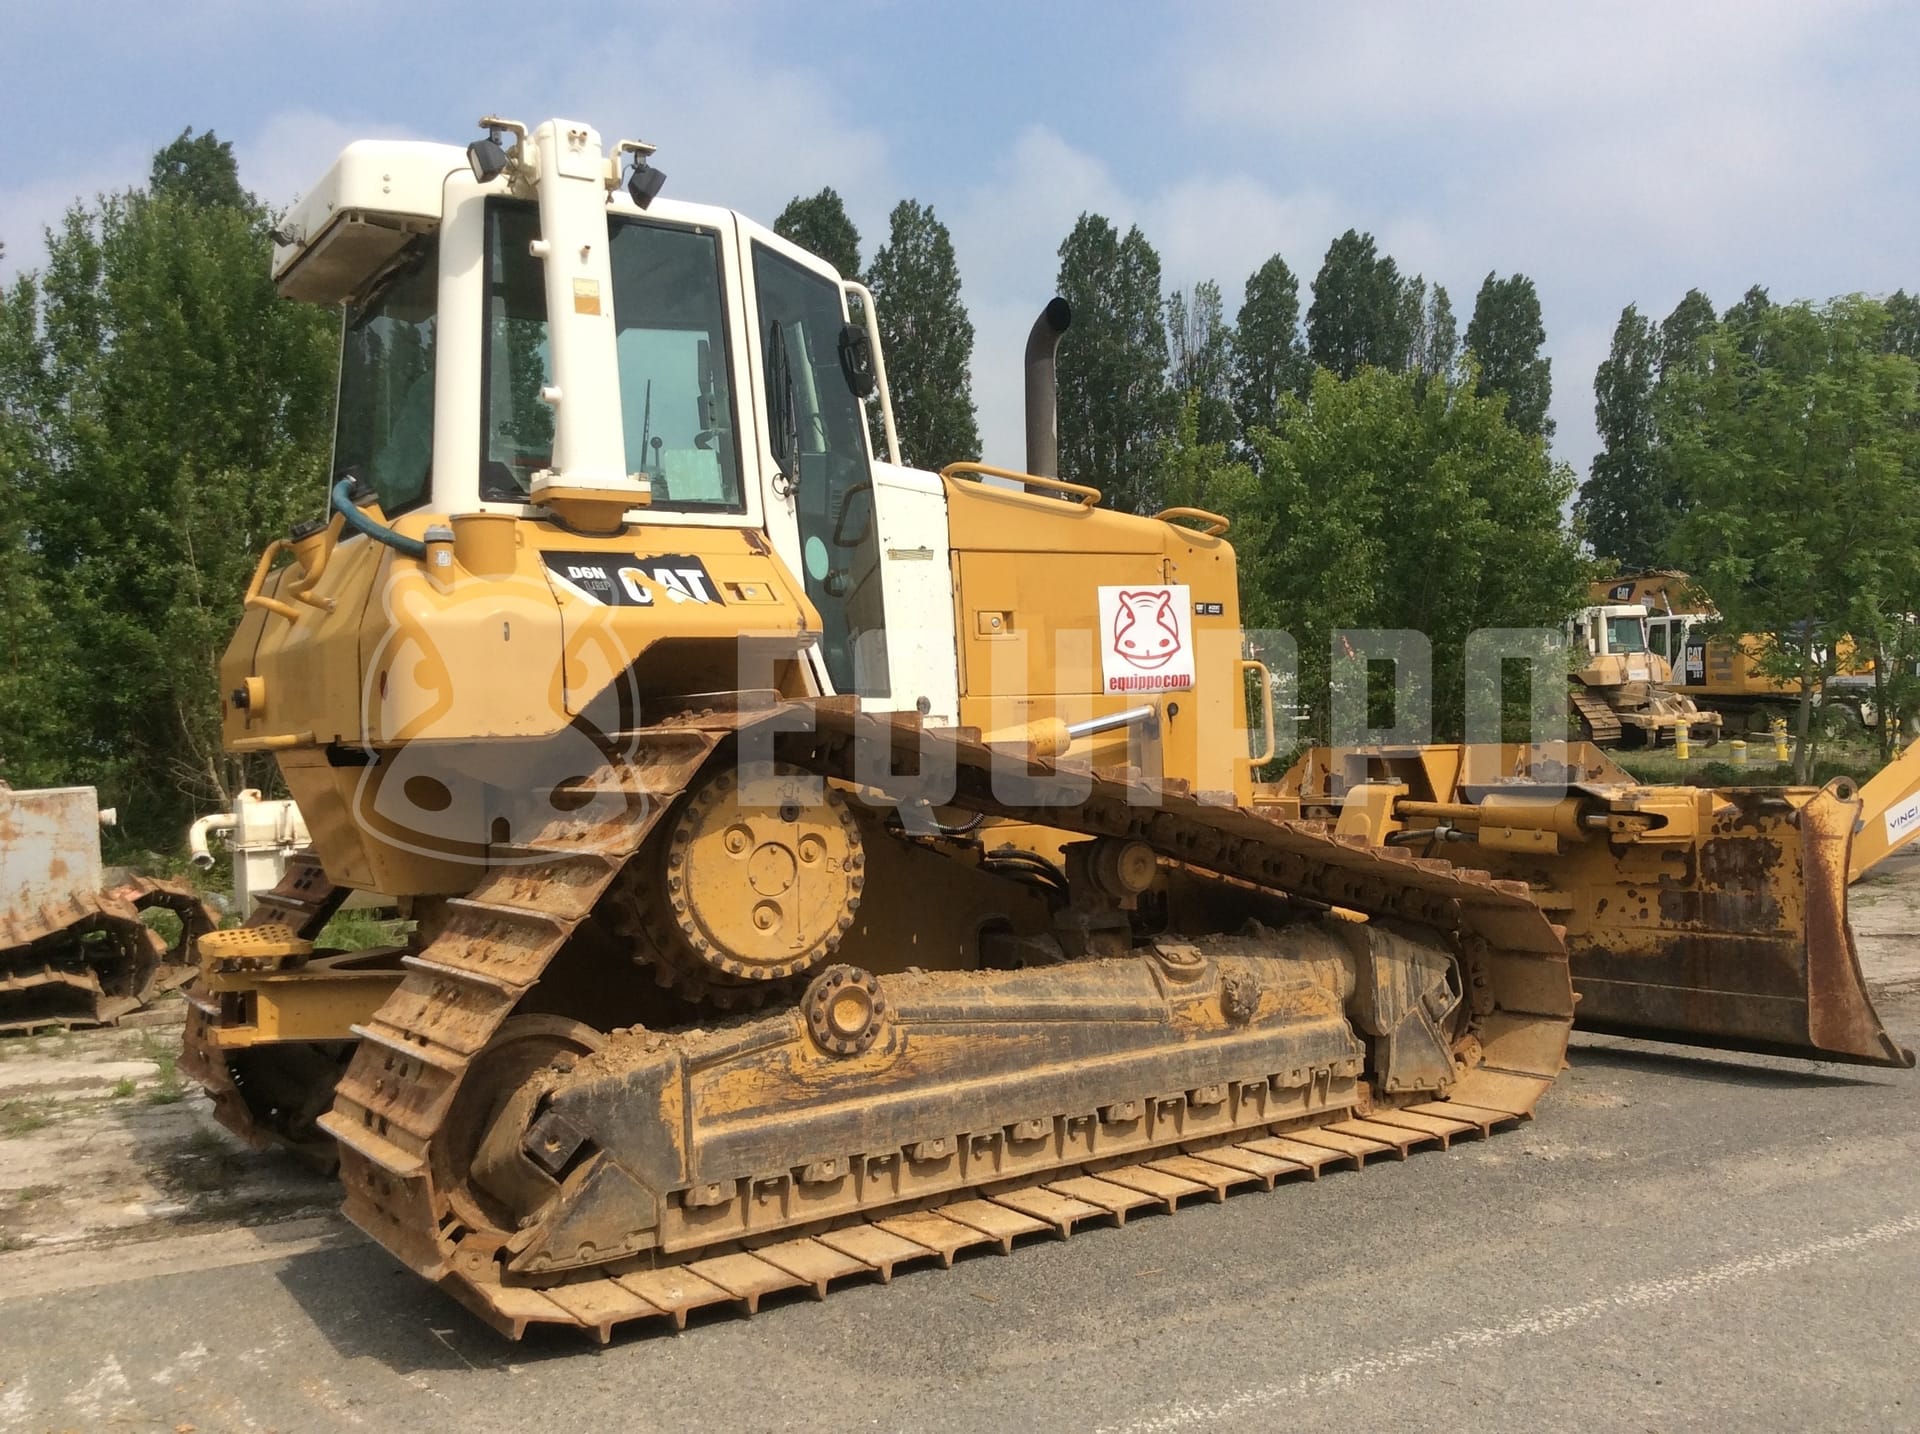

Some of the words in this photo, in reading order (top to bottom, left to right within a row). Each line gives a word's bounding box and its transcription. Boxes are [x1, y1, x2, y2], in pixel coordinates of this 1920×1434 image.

[567, 566, 607, 580] D6N
[617, 566, 709, 604] CAT
[1617, 587, 1630, 599] CAT
[1687, 646, 1703, 662] CAT
[1109, 673, 1191, 691] equippo.com
[1890, 806, 1918, 828] VINCI
